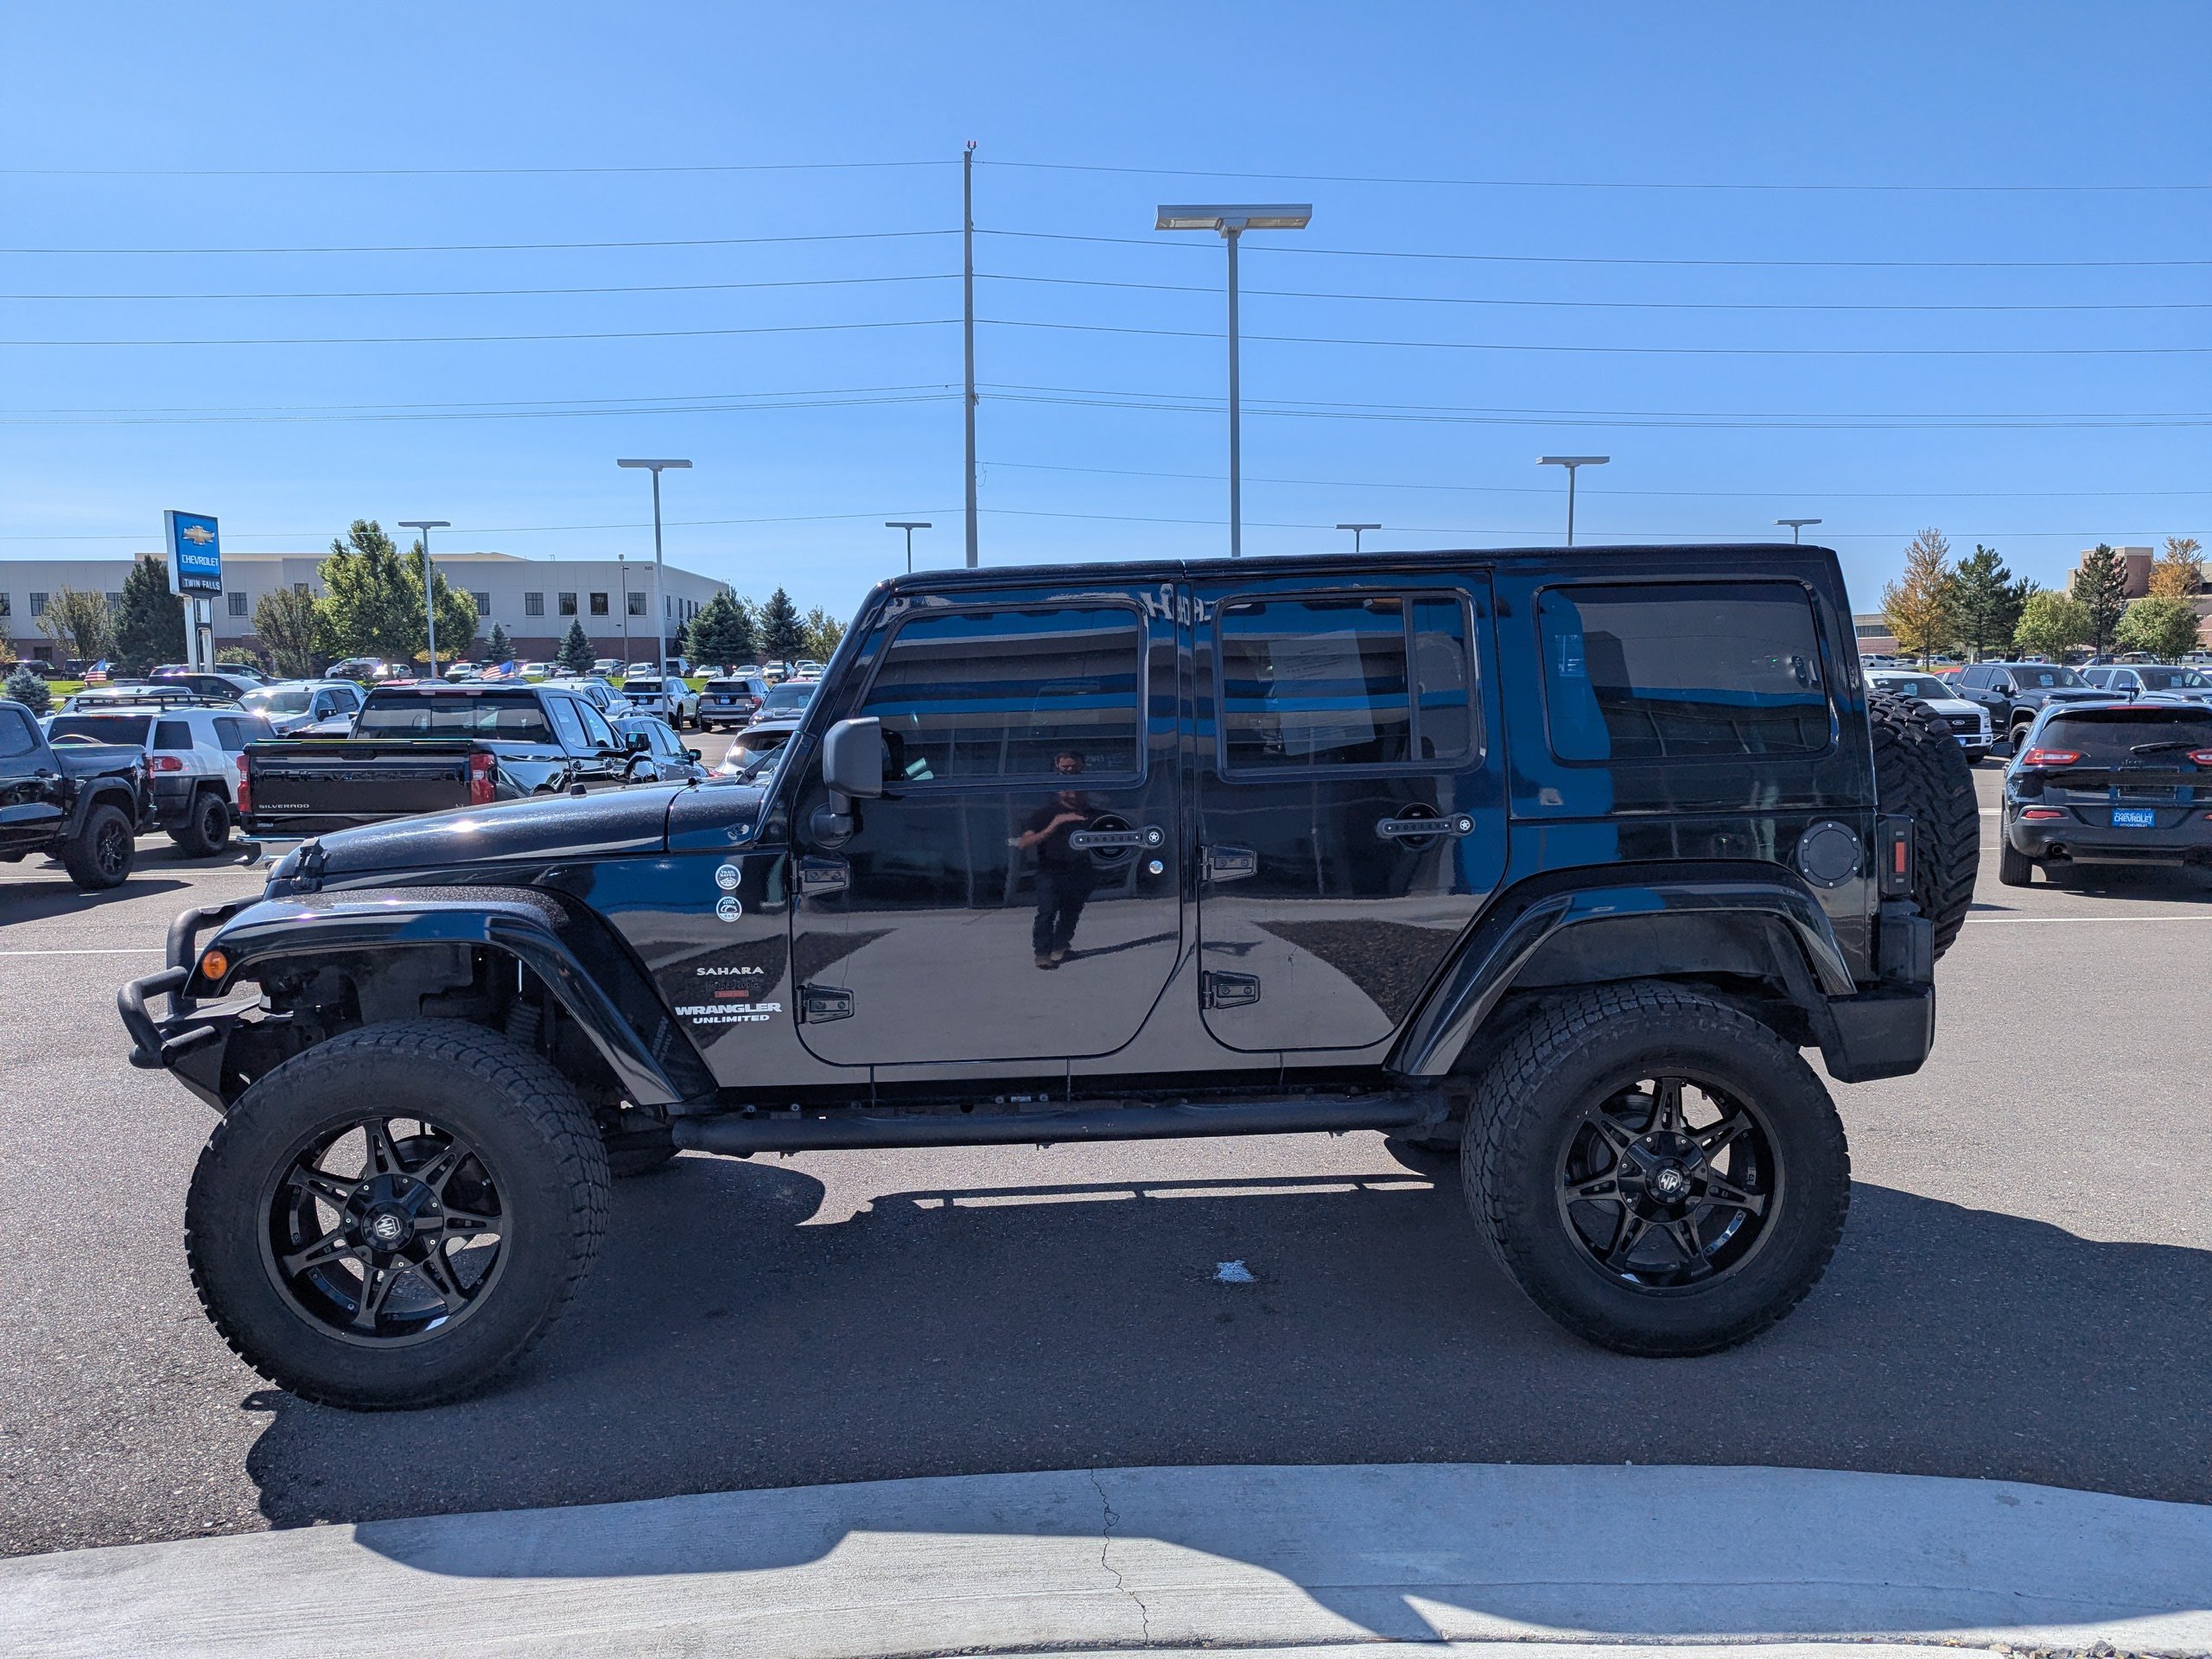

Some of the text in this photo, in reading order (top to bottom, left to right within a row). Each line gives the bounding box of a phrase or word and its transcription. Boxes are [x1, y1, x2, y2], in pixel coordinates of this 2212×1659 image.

[181, 554, 219, 567] CHEVROLET
[183, 578, 221, 590] TWIN FALLS
[696, 966, 765, 976] SAHARA
[675, 1002, 783, 1015] WRANGLER
[693, 1014, 770, 1024] UNLIMITED
